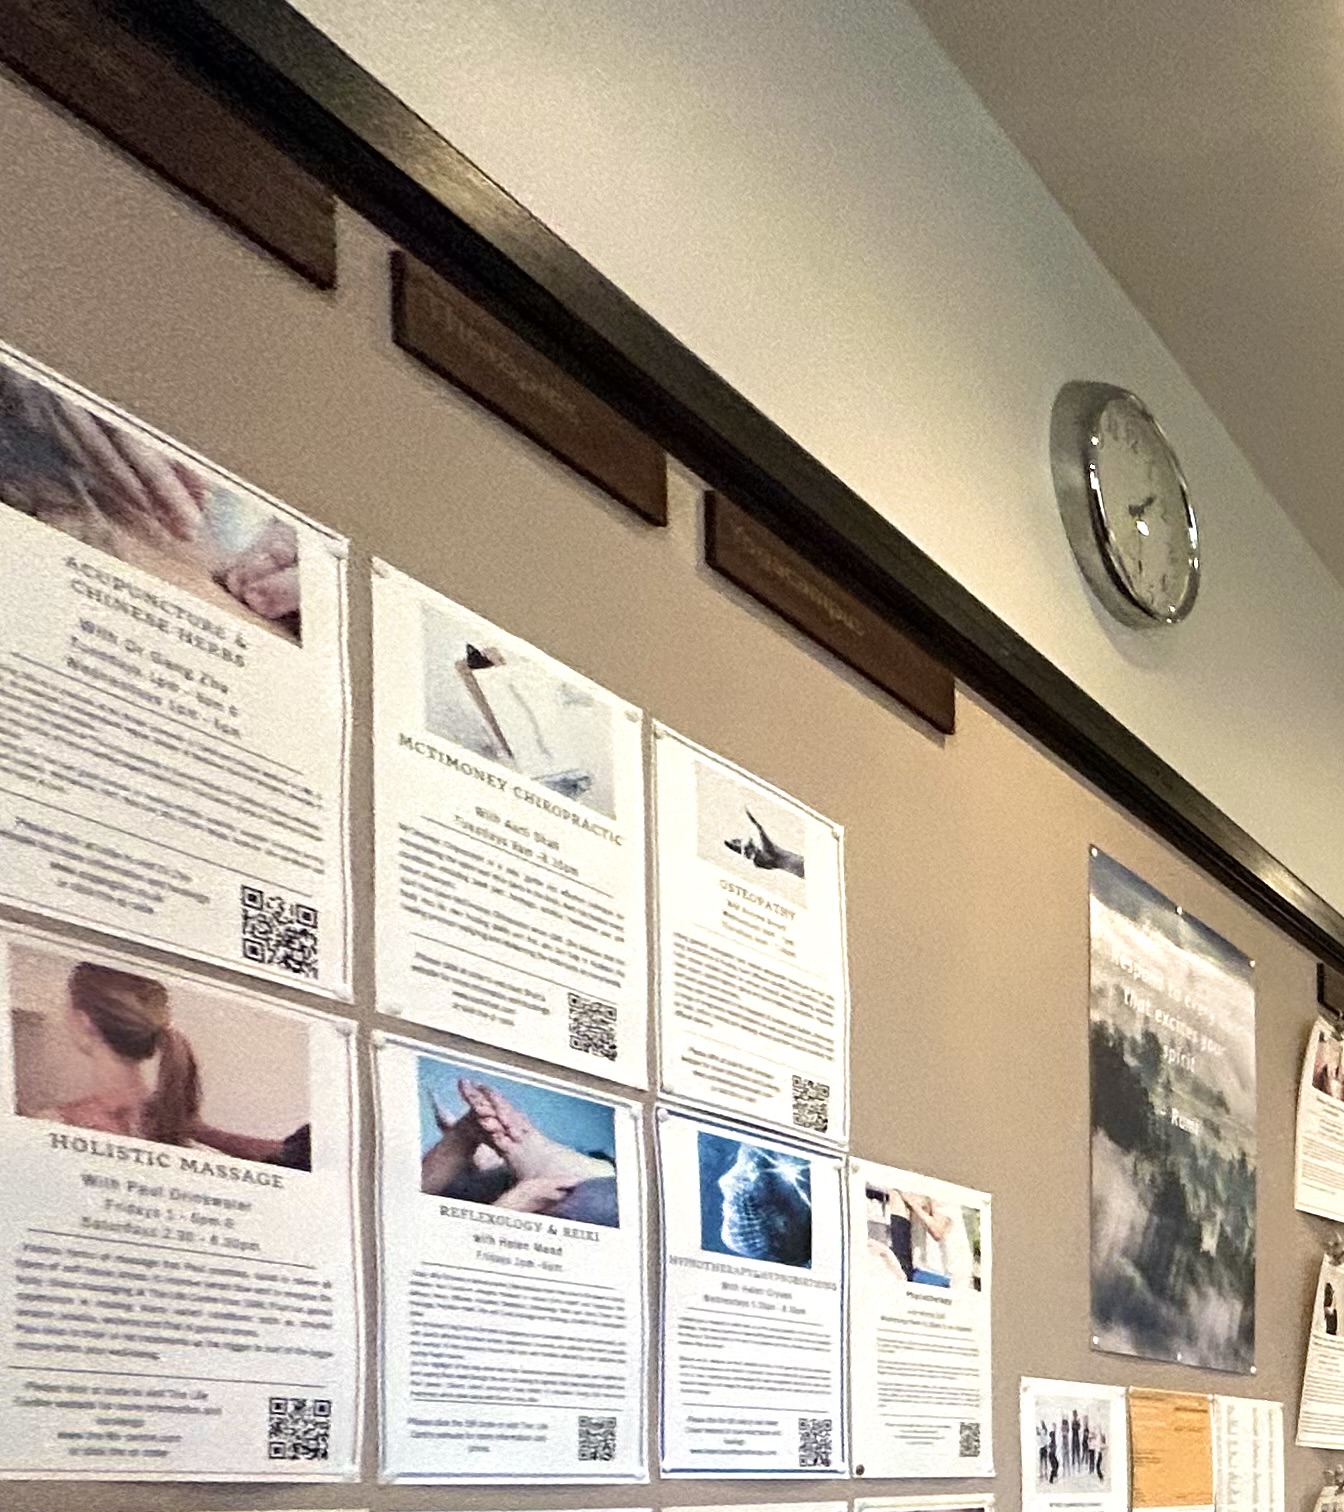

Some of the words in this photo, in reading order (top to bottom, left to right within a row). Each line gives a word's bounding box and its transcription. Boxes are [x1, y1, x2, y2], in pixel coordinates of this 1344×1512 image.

[64, 556, 226, 640] ACUPUNCTURE
[234, 632, 248, 650] &
[71, 578, 170, 634] CHINESE
[178, 626, 245, 668] HERBS
[399, 731, 508, 793] MCTIMONEY
[513, 785, 624, 846] CHIROPRACTIC
[719, 879, 797, 921] OSTEOPATHY
[1123, 988, 1152, 1015] that
[1161, 1044, 1197, 1073] spirit
[1170, 1106, 1201, 1137] Rumi
[48, 1132, 171, 1170] HOLISTIC
[179, 1156, 285, 1190] MASSAGE
[439, 1203, 544, 1234] REFLEXOLOGY
[547, 1223, 559, 1236] &
[563, 1226, 601, 1243] REIKI
